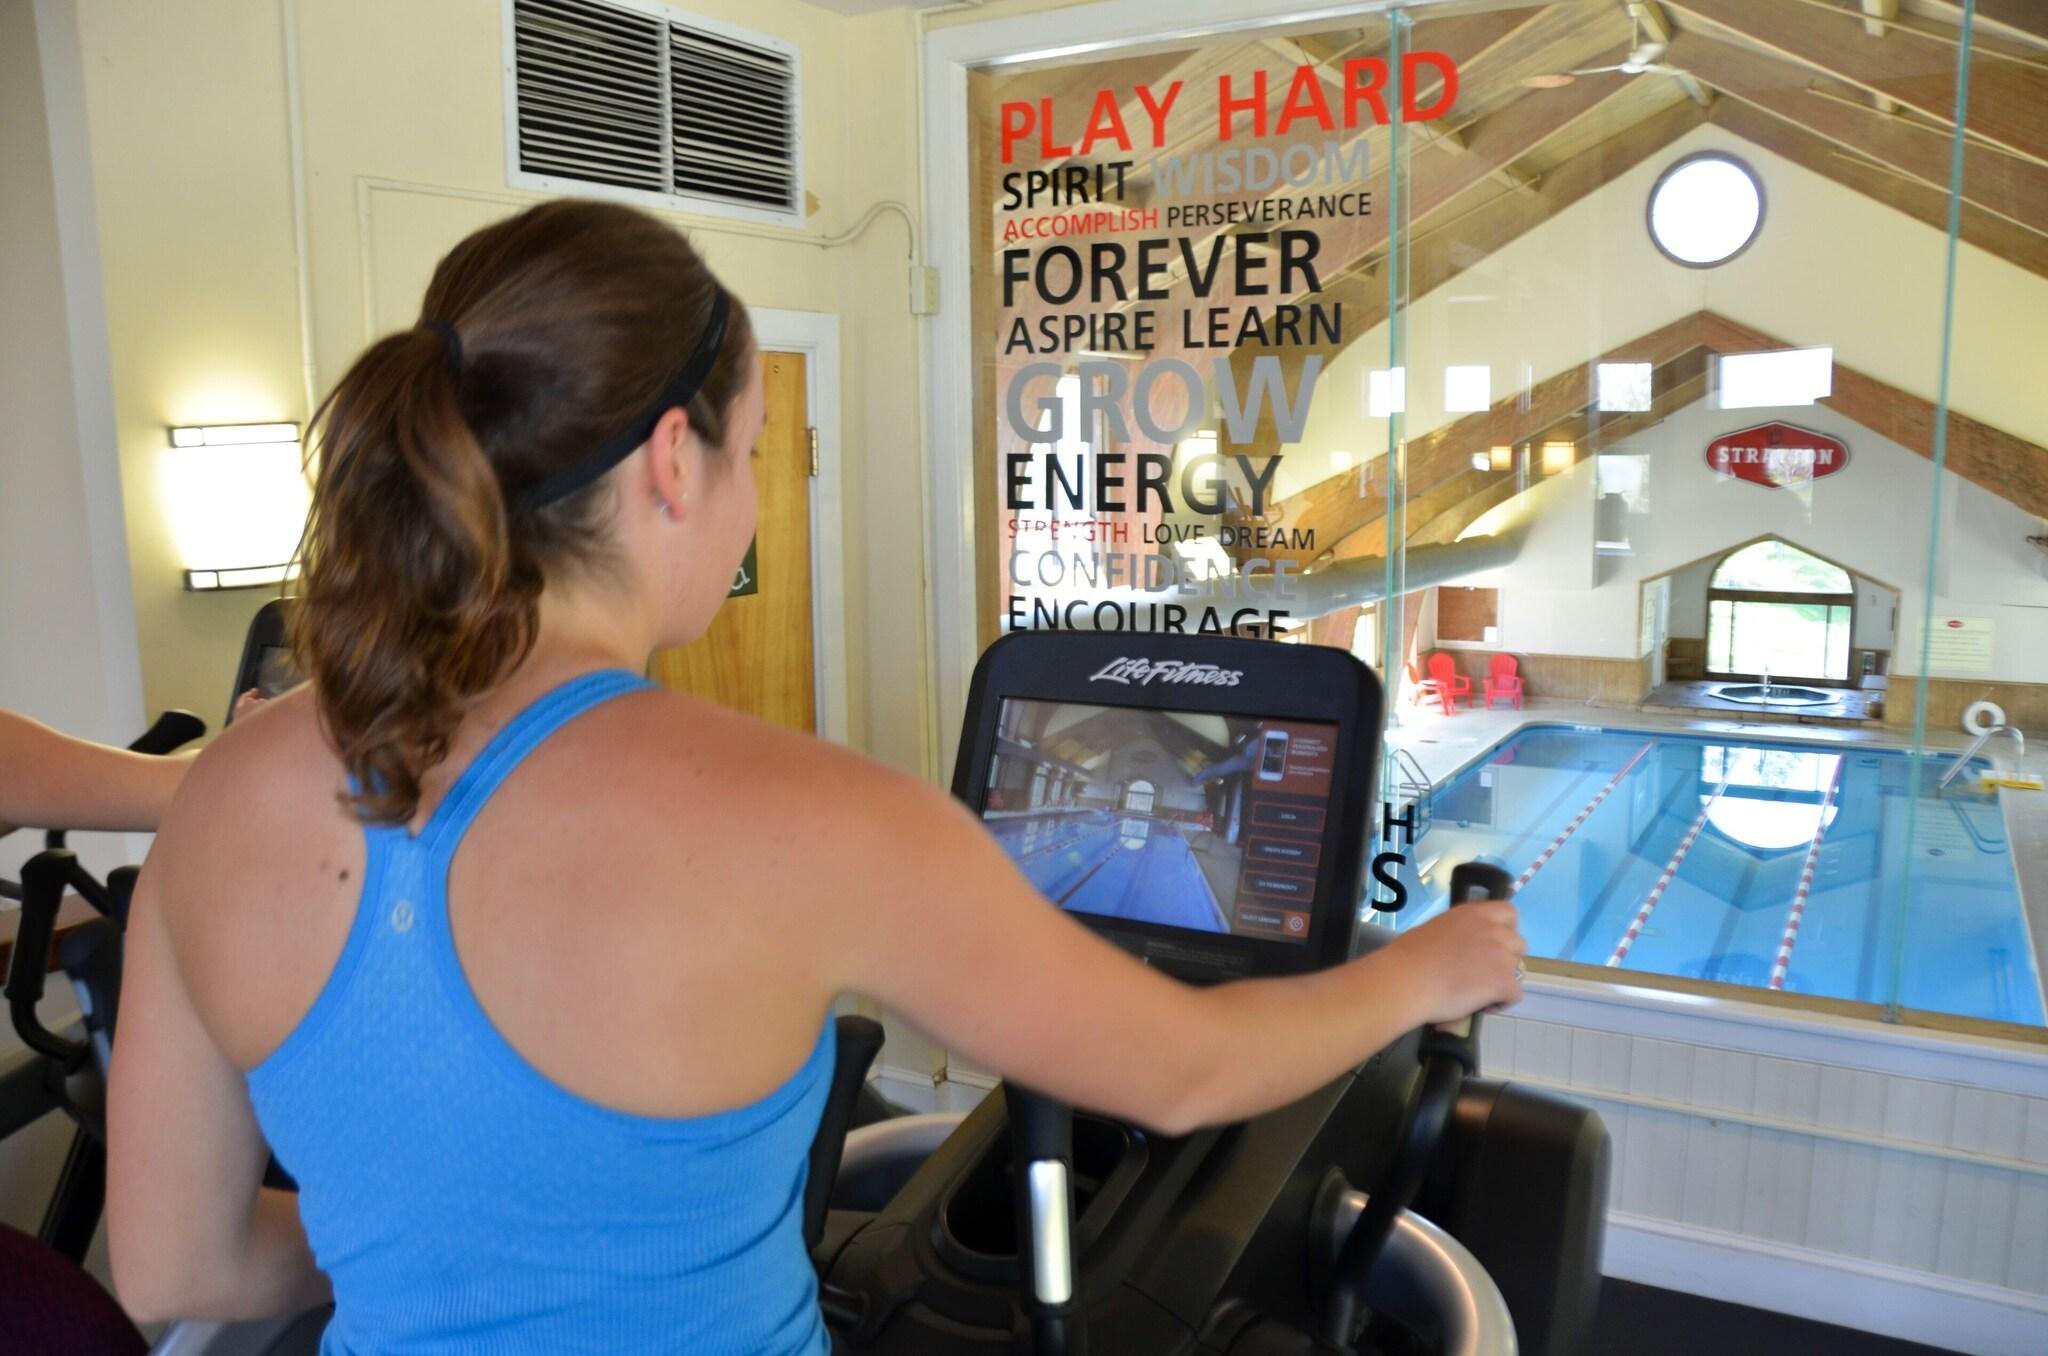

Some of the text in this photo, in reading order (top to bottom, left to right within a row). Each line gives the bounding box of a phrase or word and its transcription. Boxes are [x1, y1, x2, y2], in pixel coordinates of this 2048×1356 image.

[1001, 51, 1460, 164] PLAY HARD
[1003, 139, 1370, 211] SPIRIT WISDOM
[1003, 193, 1372, 240] ACCOMPLISH PERSEVERANCE
[1003, 229, 1323, 307] FOREVER
[1005, 302, 1342, 354] ASPIRE LEARN
[1006, 355, 1323, 444] GROW
[1006, 453, 1283, 516] ENERGY
[1008, 519, 1315, 550] STREGTH LOVE DREAM
[1009, 550, 1300, 600] CONFIDENCE
[1009, 596, 1290, 639] ENCOURAGE
